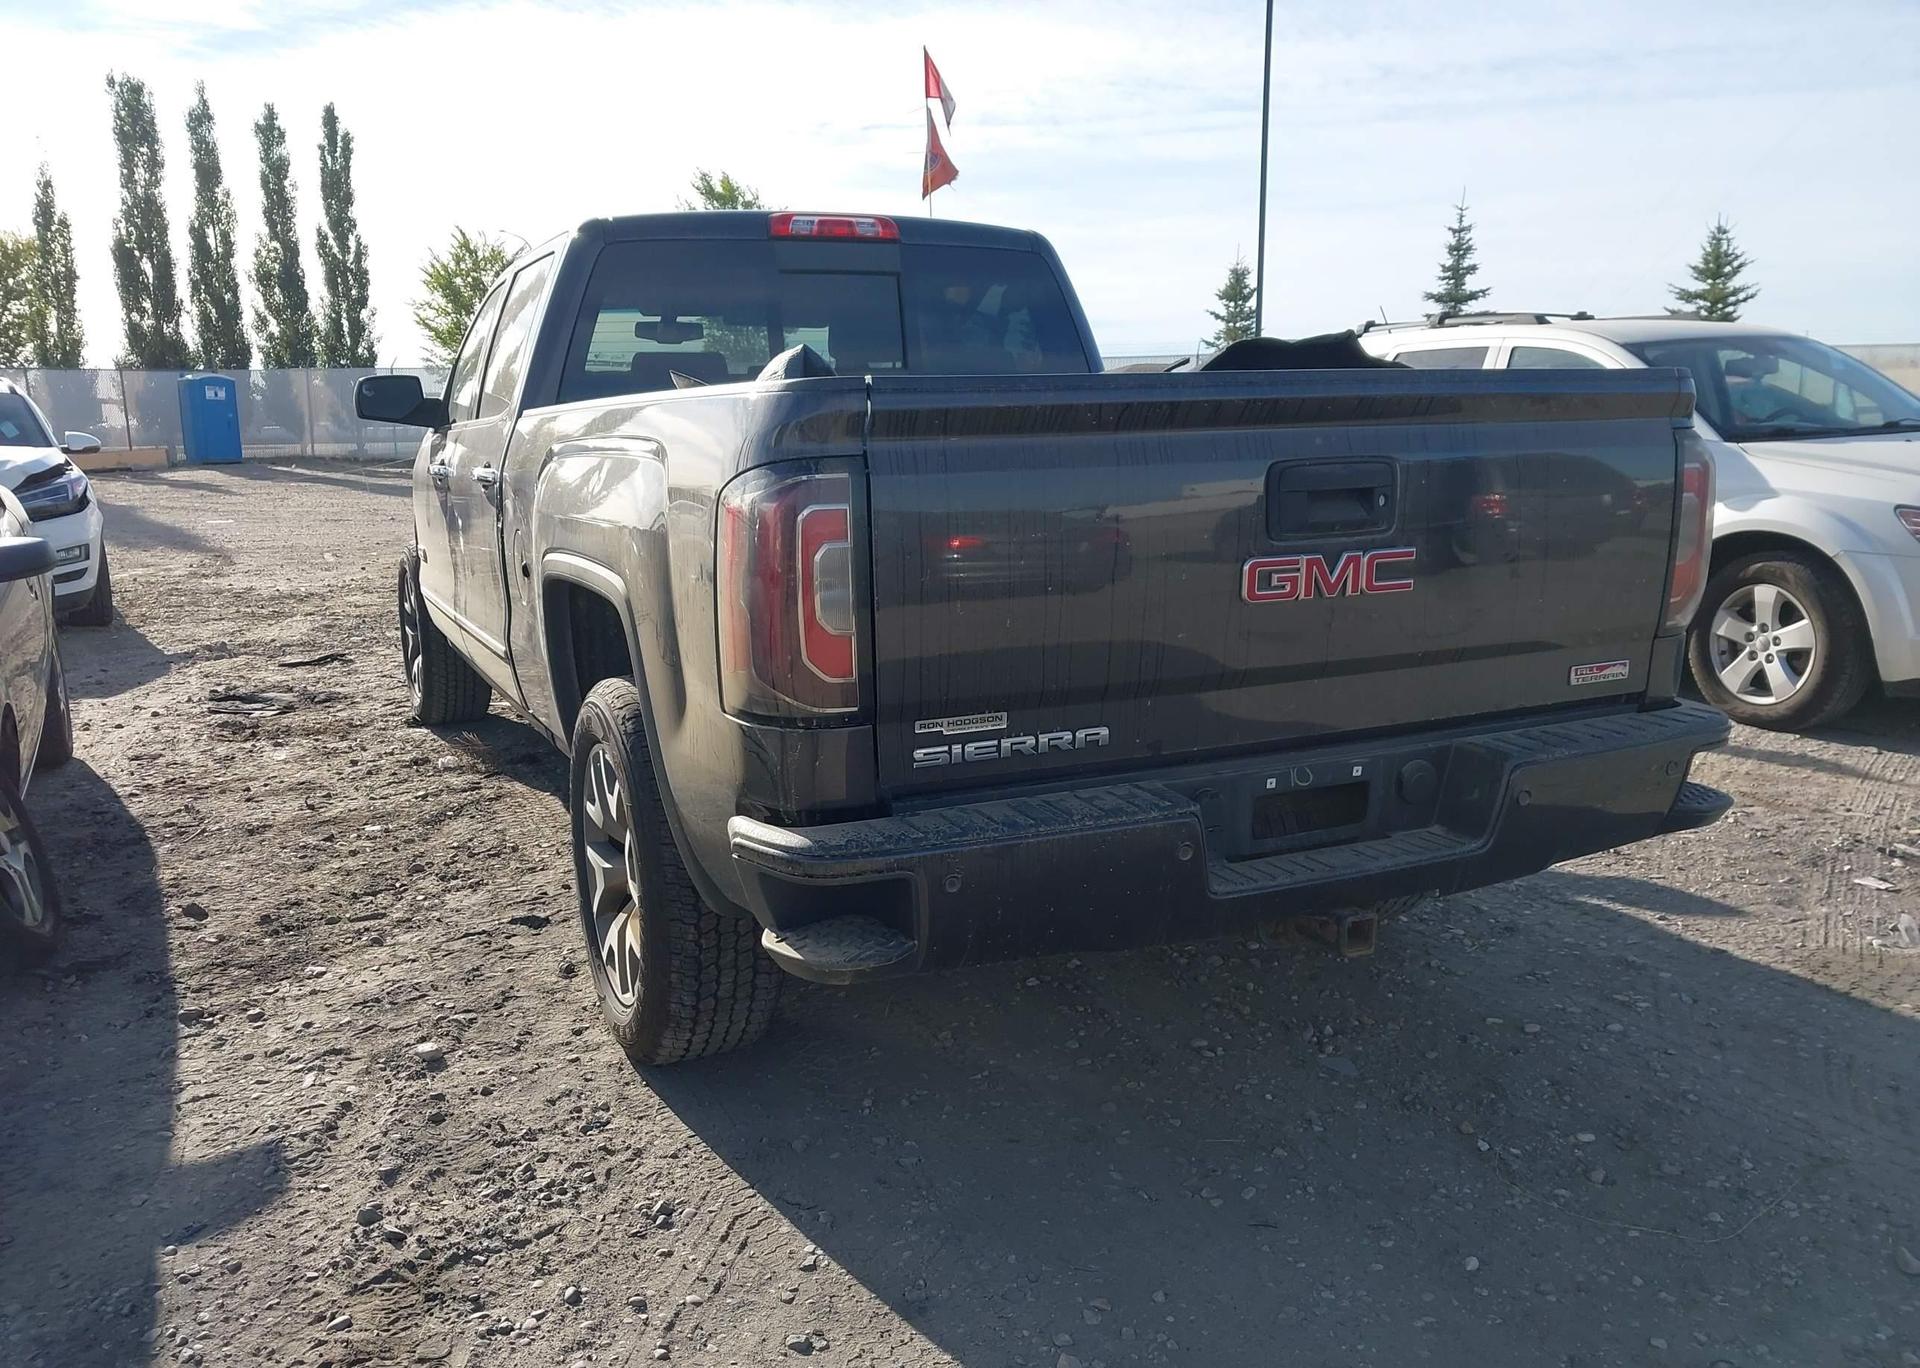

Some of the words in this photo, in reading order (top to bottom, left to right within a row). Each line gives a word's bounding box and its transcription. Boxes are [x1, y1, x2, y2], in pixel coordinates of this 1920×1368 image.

[1242, 547, 1416, 603] GMC
[1574, 671, 1627, 683] TERRAIN
[919, 720, 943, 731] RON
[947, 714, 1004, 728] HODGSON
[913, 726, 1110, 769] SIERRA
